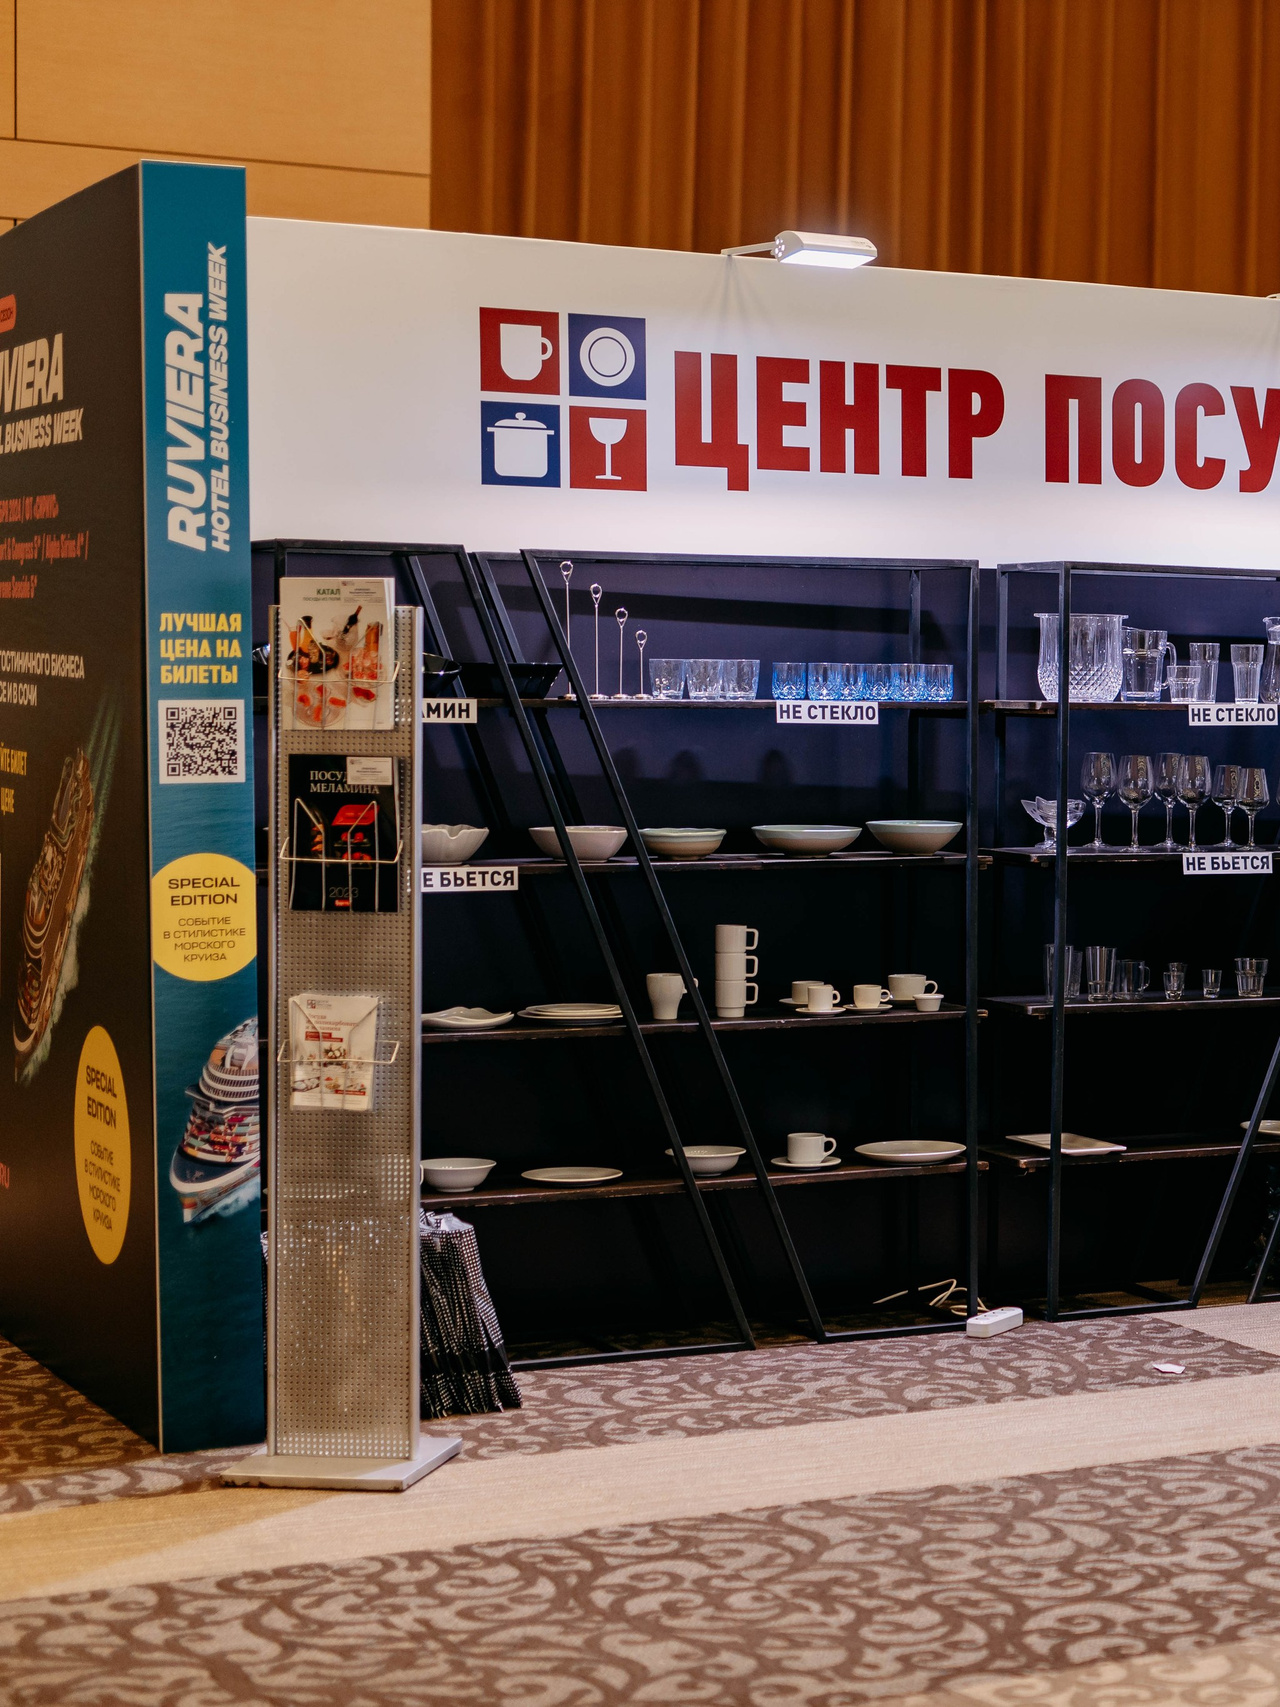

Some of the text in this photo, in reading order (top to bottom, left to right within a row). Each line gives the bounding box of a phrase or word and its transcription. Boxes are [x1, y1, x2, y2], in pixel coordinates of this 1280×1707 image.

[0, 333, 64, 413] VIERA
[207, 241, 231, 553] HOTEL BUSINESS WEEK
[164, 292, 206, 552] RUVIERA
[674, 351, 1005, 491] ЦЕНТР
[5, 414, 52, 453] BUSINESS
[53, 408, 84, 445] WEEK
[316, 588, 341, 596] КАТАЛ
[159, 613, 241, 632] ЛУЧШАЯ
[160, 639, 242, 661] ЦЕНА НА
[51, 653, 85, 680] БИЗНЕСА
[160, 665, 238, 684] БИЛЕТЫ
[18, 683, 37, 706] СОЧИ
[422, 702, 470, 718] МИН
[780, 704, 876, 720] НЕ СТЕКЛО
[1191, 707, 1276, 722] НЕ СТЕКЛО
[310, 783, 379, 794] МЕЛАМИНА
[1186, 855, 1270, 871] НЕ БЬЕТСЯ
[168, 877, 240, 889] SPECIAL
[440, 870, 515, 887] БЬЕТСЯ
[171, 893, 238, 906] EDITION
[329, 887, 359, 898] 2023
[178, 916, 231, 926] СОБЫТИЕ
[163, 928, 246, 939] В СТИЛИСТИКЕ
[174, 940, 236, 951] МОРСКОГО
[183, 953, 227, 962] КРУИЗА
[86, 1065, 117, 1098] SPECIAL
[87, 1096, 117, 1129] EDITION
[90, 1140, 114, 1166] СОБЫТИЕ
